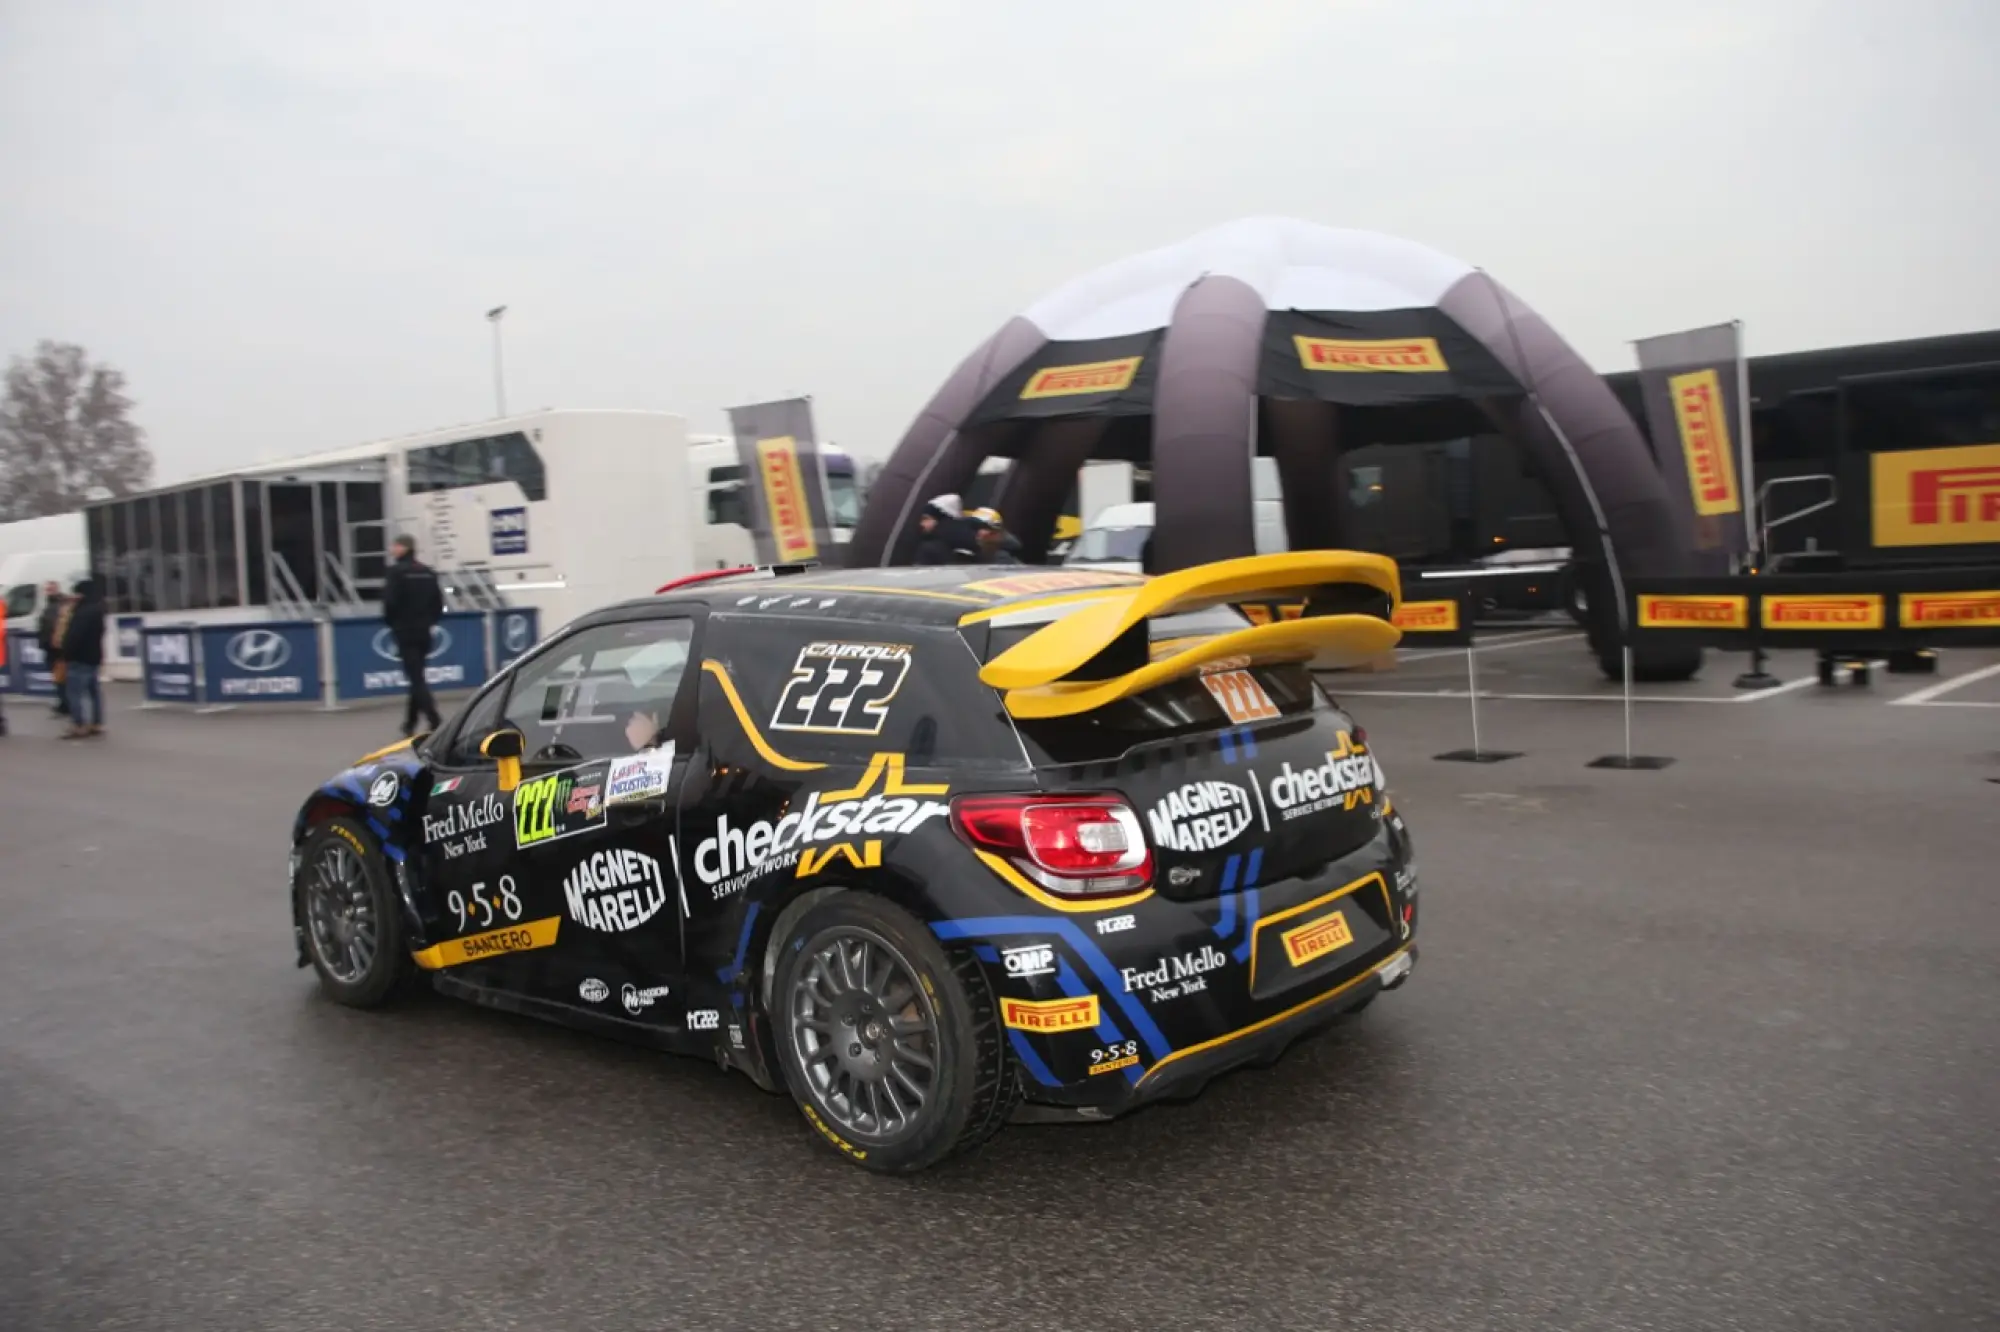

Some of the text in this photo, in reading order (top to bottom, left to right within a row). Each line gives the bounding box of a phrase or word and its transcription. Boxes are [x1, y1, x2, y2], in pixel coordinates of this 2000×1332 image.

[1312, 343, 1430, 366] PIRELLI
[1035, 363, 1128, 392] PIRELLI
[1683, 383, 1729, 502] PIRELLI
[766, 449, 808, 550] PIRELLI
[807, 642, 911, 661] CAIROLI
[770, 648, 912, 736] 222
[1206, 672, 1280, 721] 222
[422, 793, 504, 844] Fred Mello
[516, 776, 557, 844] 222
[444, 832, 487, 860] New York
[694, 792, 950, 884] checkstar
[463, 929, 532, 957] SANTERO
[1288, 917, 1346, 959] PIRELLI
[1005, 950, 1054, 973] OMP
[1122, 945, 1227, 993] Fred Mello
[1152, 976, 1207, 1003] New York
[1007, 1001, 1092, 1028] PIRELLI
